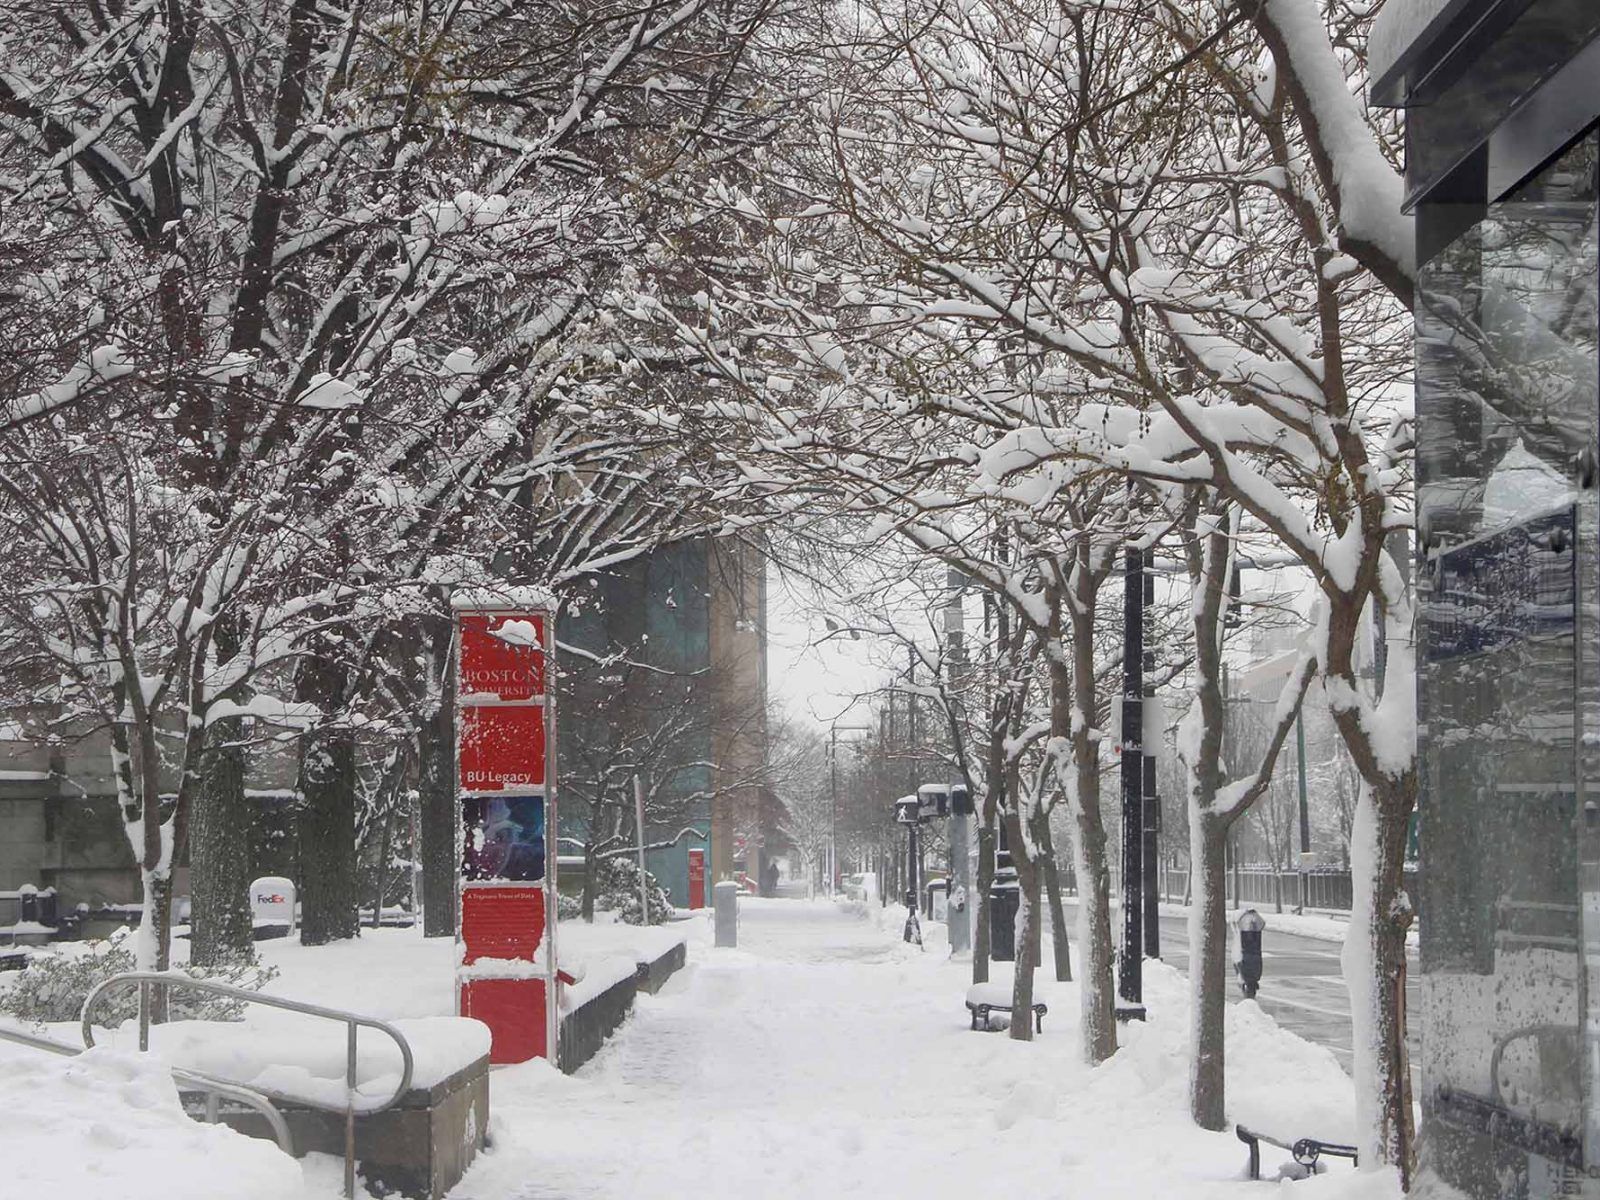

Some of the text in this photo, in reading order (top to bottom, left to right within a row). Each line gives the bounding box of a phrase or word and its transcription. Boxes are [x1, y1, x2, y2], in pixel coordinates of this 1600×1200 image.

[465, 669, 540, 682] BOSTON
[467, 771, 531, 784] BU Legacy
[257, 894, 285, 904] FedEx
